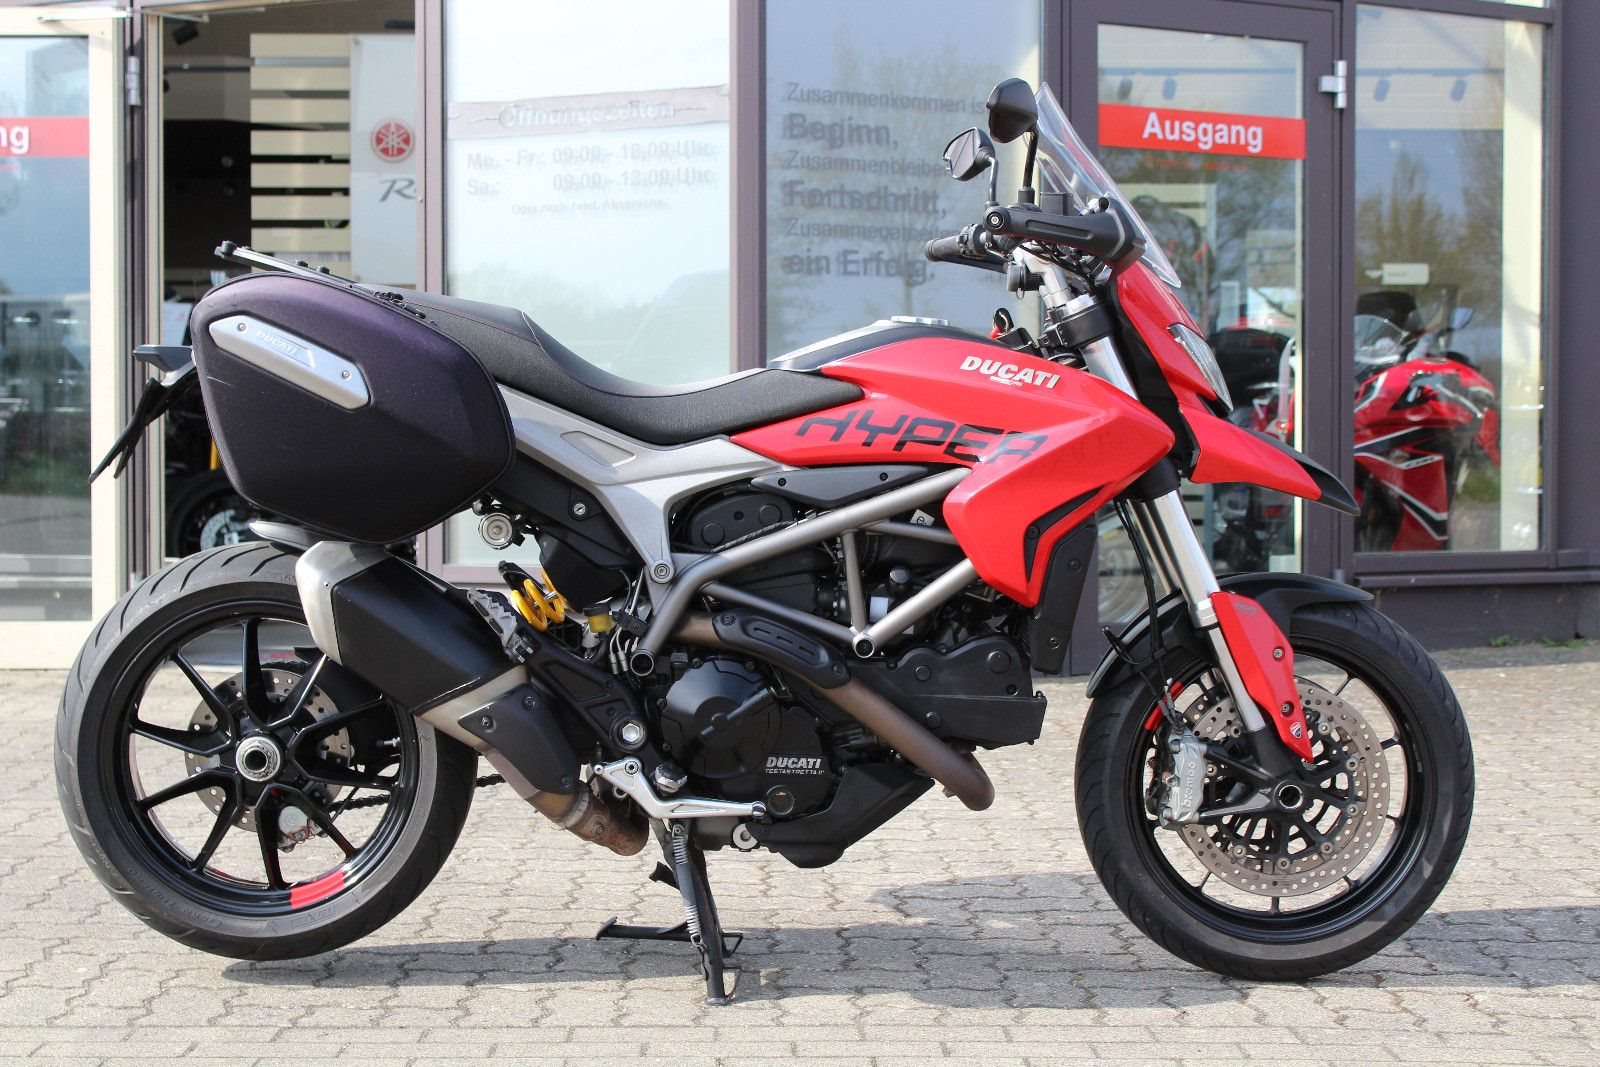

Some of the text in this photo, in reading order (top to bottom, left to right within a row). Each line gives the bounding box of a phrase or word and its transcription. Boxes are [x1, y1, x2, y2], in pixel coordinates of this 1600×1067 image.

[785, 82, 966, 113] Zusammenkommen
[784, 112, 898, 150] Beginn,
[1142, 112, 1263, 153] Ausgang
[785, 150, 947, 178] Zusammenbleibe
[379, 177, 416, 203] R
[784, 180, 946, 218] Fortschritt,
[783, 248, 935, 285] ein Erfolg.
[959, 355, 1062, 390] DUCATI
[795, 409, 1049, 465] HYPER
[765, 756, 822, 769] DUCATI
[1180, 761, 1197, 809] brembo
